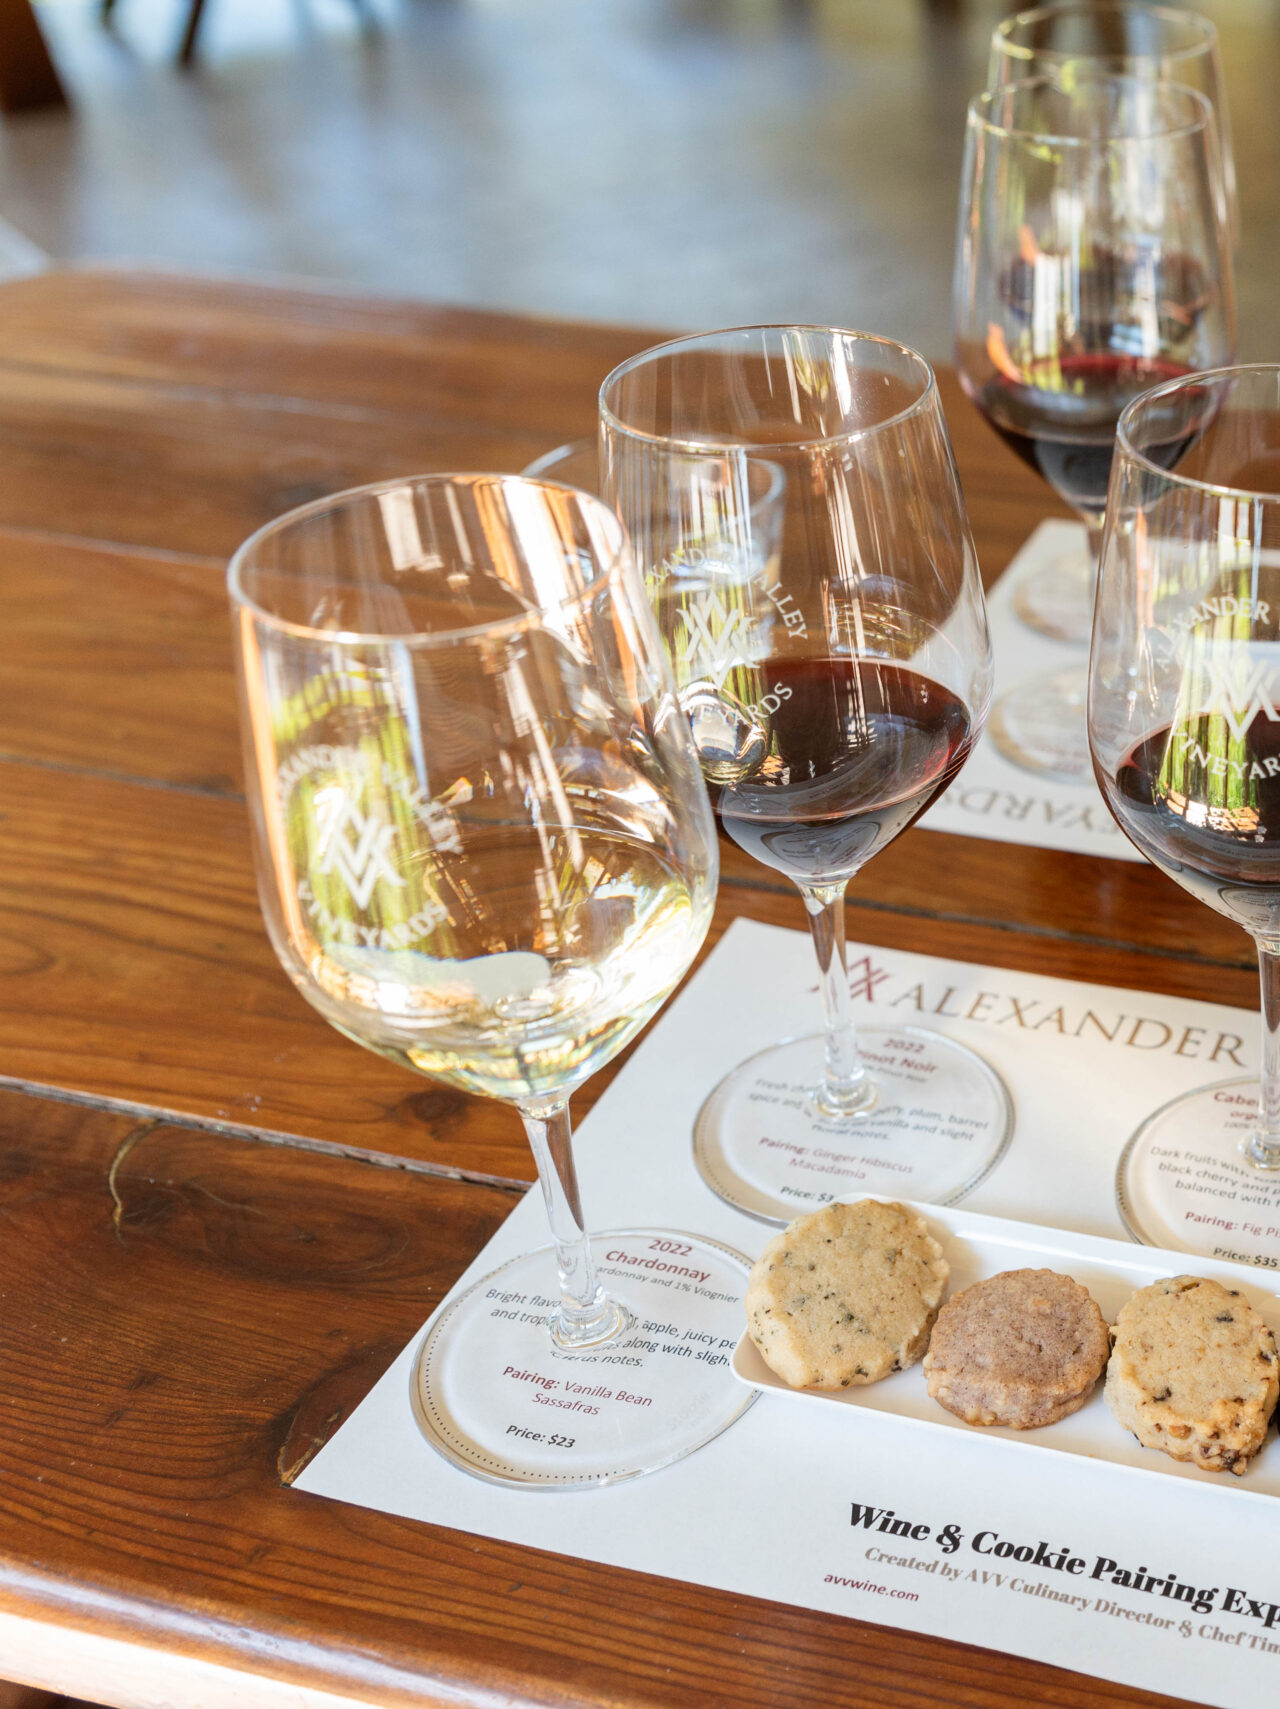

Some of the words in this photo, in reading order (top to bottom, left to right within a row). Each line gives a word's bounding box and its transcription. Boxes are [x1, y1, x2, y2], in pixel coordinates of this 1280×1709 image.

[753, 573, 808, 640] ALLEY
[697, 681, 794, 728] EYARDS
[889, 982, 1248, 1068] ALEXANDER
[901, 1056, 938, 1074] Noir
[947, 1113, 989, 1130] barrel
[759, 1136, 808, 1156] Pairing:
[812, 1147, 857, 1165] Ginger
[1151, 1145, 1181, 1160] Dark
[1184, 1151, 1218, 1167] fruits
[788, 1157, 867, 1180] Macadamia
[1158, 1160, 1193, 1175] black
[1195, 1168, 1239, 1186] cherry
[1241, 1180, 1270, 1193] and
[1175, 1179, 1237, 1200] balanced
[1240, 1190, 1272, 1206] with
[1185, 1210, 1239, 1232] Pairing:
[1242, 1221, 1264, 1237] Fig
[649, 1239, 693, 1257] 2022
[1212, 1245, 1250, 1263] Price:
[1253, 1253, 1279, 1269] $35
[605, 1250, 711, 1283] Chardonnay
[597, 1266, 649, 1284] ardonnay
[651, 1276, 674, 1288] and
[674, 1281, 692, 1293] 1%
[694, 1286, 740, 1305] Viognier
[485, 1288, 527, 1307] Bright
[530, 1295, 562, 1309] flavo
[641, 1319, 680, 1339] apple,
[682, 1328, 719, 1346] juicy
[491, 1307, 518, 1322] and
[622, 1336, 659, 1355] along
[662, 1343, 694, 1359] with
[695, 1350, 731, 1367] sligh
[601, 1354, 645, 1369] notes.
[502, 1365, 560, 1390] Pairing:
[565, 1380, 613, 1400] Vanilla
[615, 1389, 653, 1409] Bean
[532, 1392, 600, 1417] Sassafras
[506, 1424, 546, 1443] Price:
[548, 1433, 576, 1450] $23
[850, 1502, 931, 1541] Wine
[935, 1524, 965, 1553] &
[971, 1531, 1086, 1575] Cookie
[1088, 1555, 1220, 1614] Pairing
[823, 1572, 921, 1602] avvwine.com
[864, 1546, 939, 1576] Created
[940, 1560, 964, 1582] by
[964, 1568, 1010, 1588] AVV
[1009, 1577, 1091, 1613] Culinary
[1093, 1597, 1176, 1631] Director
[1178, 1619, 1194, 1638] &
[1198, 1622, 1248, 1647] Chef
